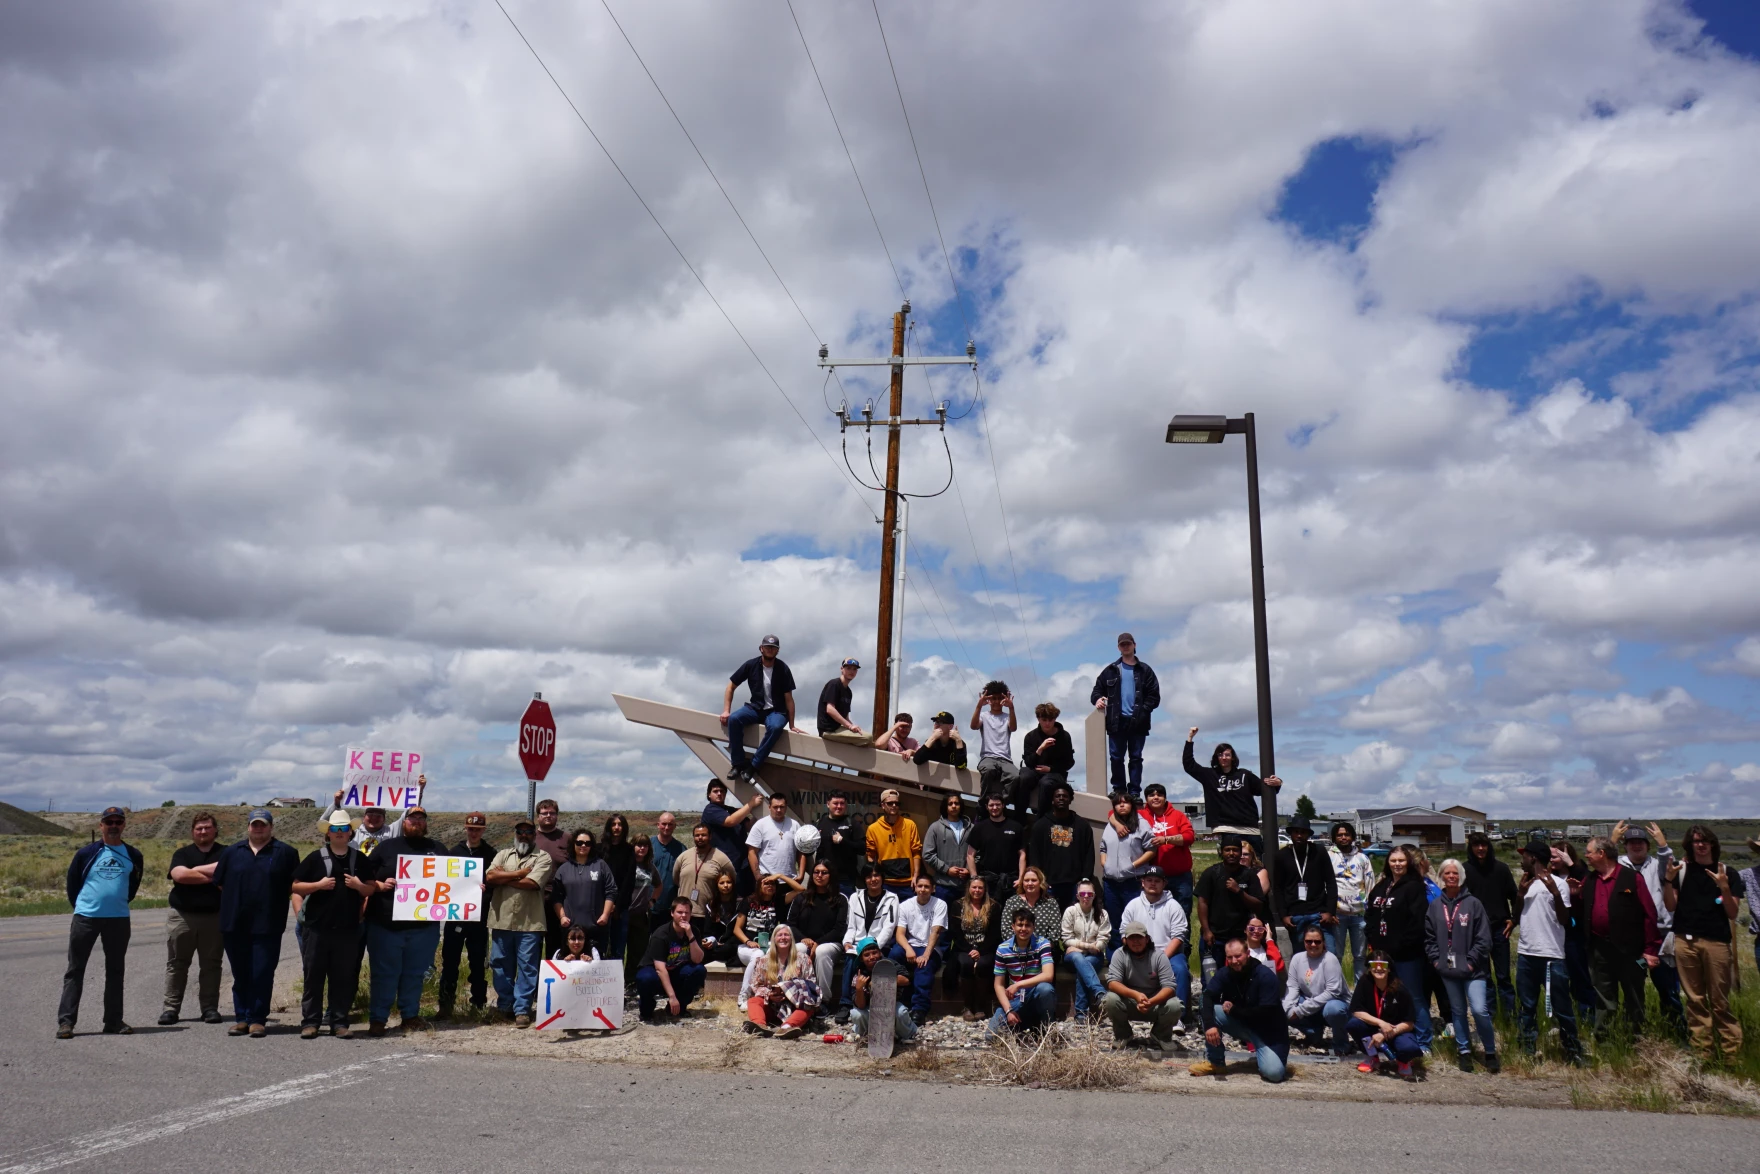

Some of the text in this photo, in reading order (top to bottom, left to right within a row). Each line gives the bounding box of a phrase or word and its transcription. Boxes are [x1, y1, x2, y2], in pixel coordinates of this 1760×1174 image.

[521, 723, 554, 757] STOP
[349, 750, 421, 773] KEEP
[344, 784, 417, 809] ALIVE
[398, 856, 477, 879] KEEP
[413, 902, 477, 921] CORP
[576, 986, 602, 996] BUILD
[586, 997, 618, 1007] FUTURES
